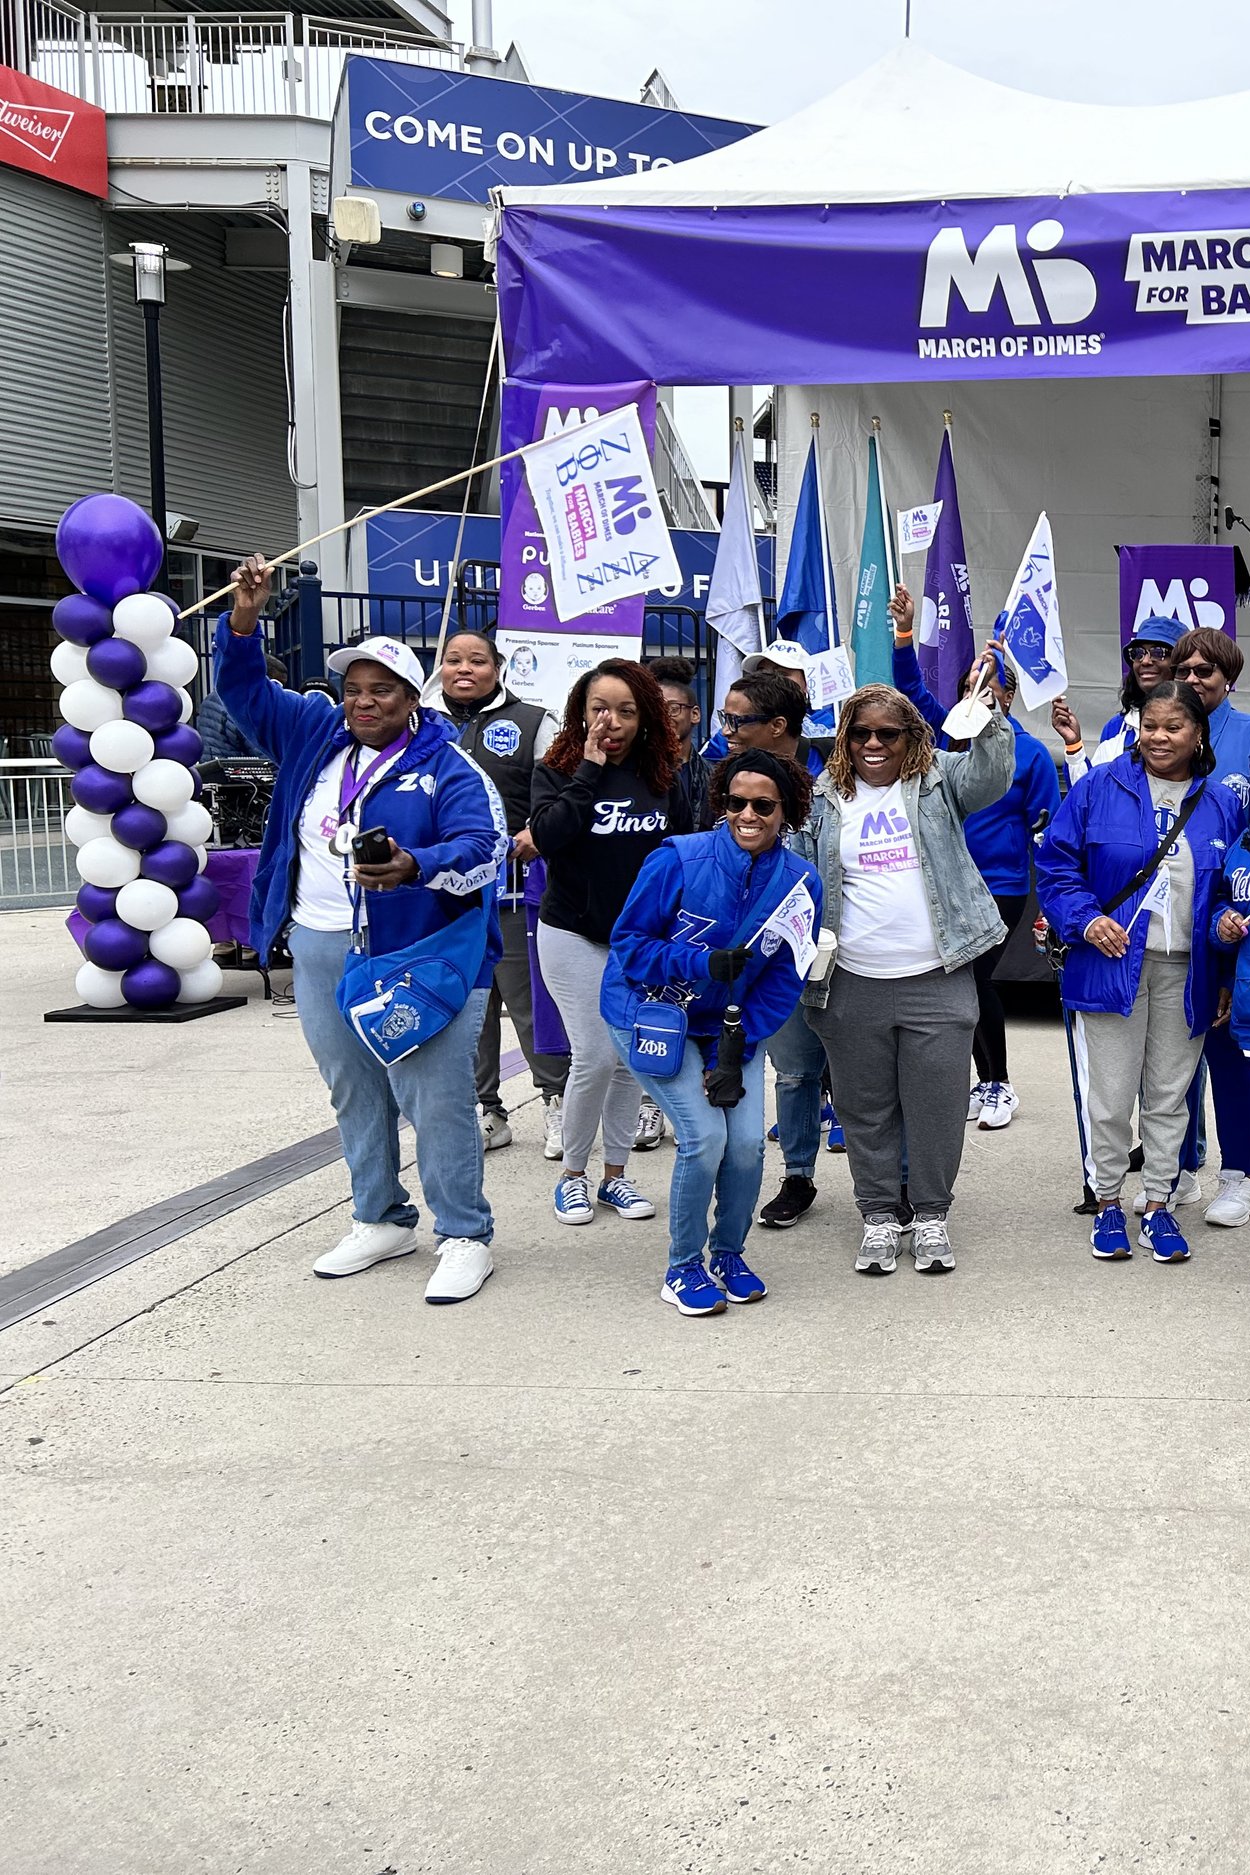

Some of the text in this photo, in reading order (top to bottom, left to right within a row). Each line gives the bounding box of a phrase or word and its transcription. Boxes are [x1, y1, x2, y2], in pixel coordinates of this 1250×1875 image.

[364, 110, 484, 155] COME
[496, 132, 554, 166] ON
[569, 142, 618, 174] UP
[1147, 286, 1188, 304] FOR
[918, 338, 996, 358] MARCH
[1000, 336, 1028, 357] OF
[574, 486, 595, 539] MARCH
[593, 482, 606, 509] MARCH
[602, 519, 613, 542] DIMES
[567, 494, 585, 559] FOR BABIES
[505, 637, 536, 645] Presenting
[591, 798, 668, 835] Finer
[859, 839, 883, 848] MARCH
[861, 849, 905, 864] MARCH
[881, 859, 919, 872] BABIES
[713, 1265, 725, 1278] N
[671, 1278, 686, 1293] N
